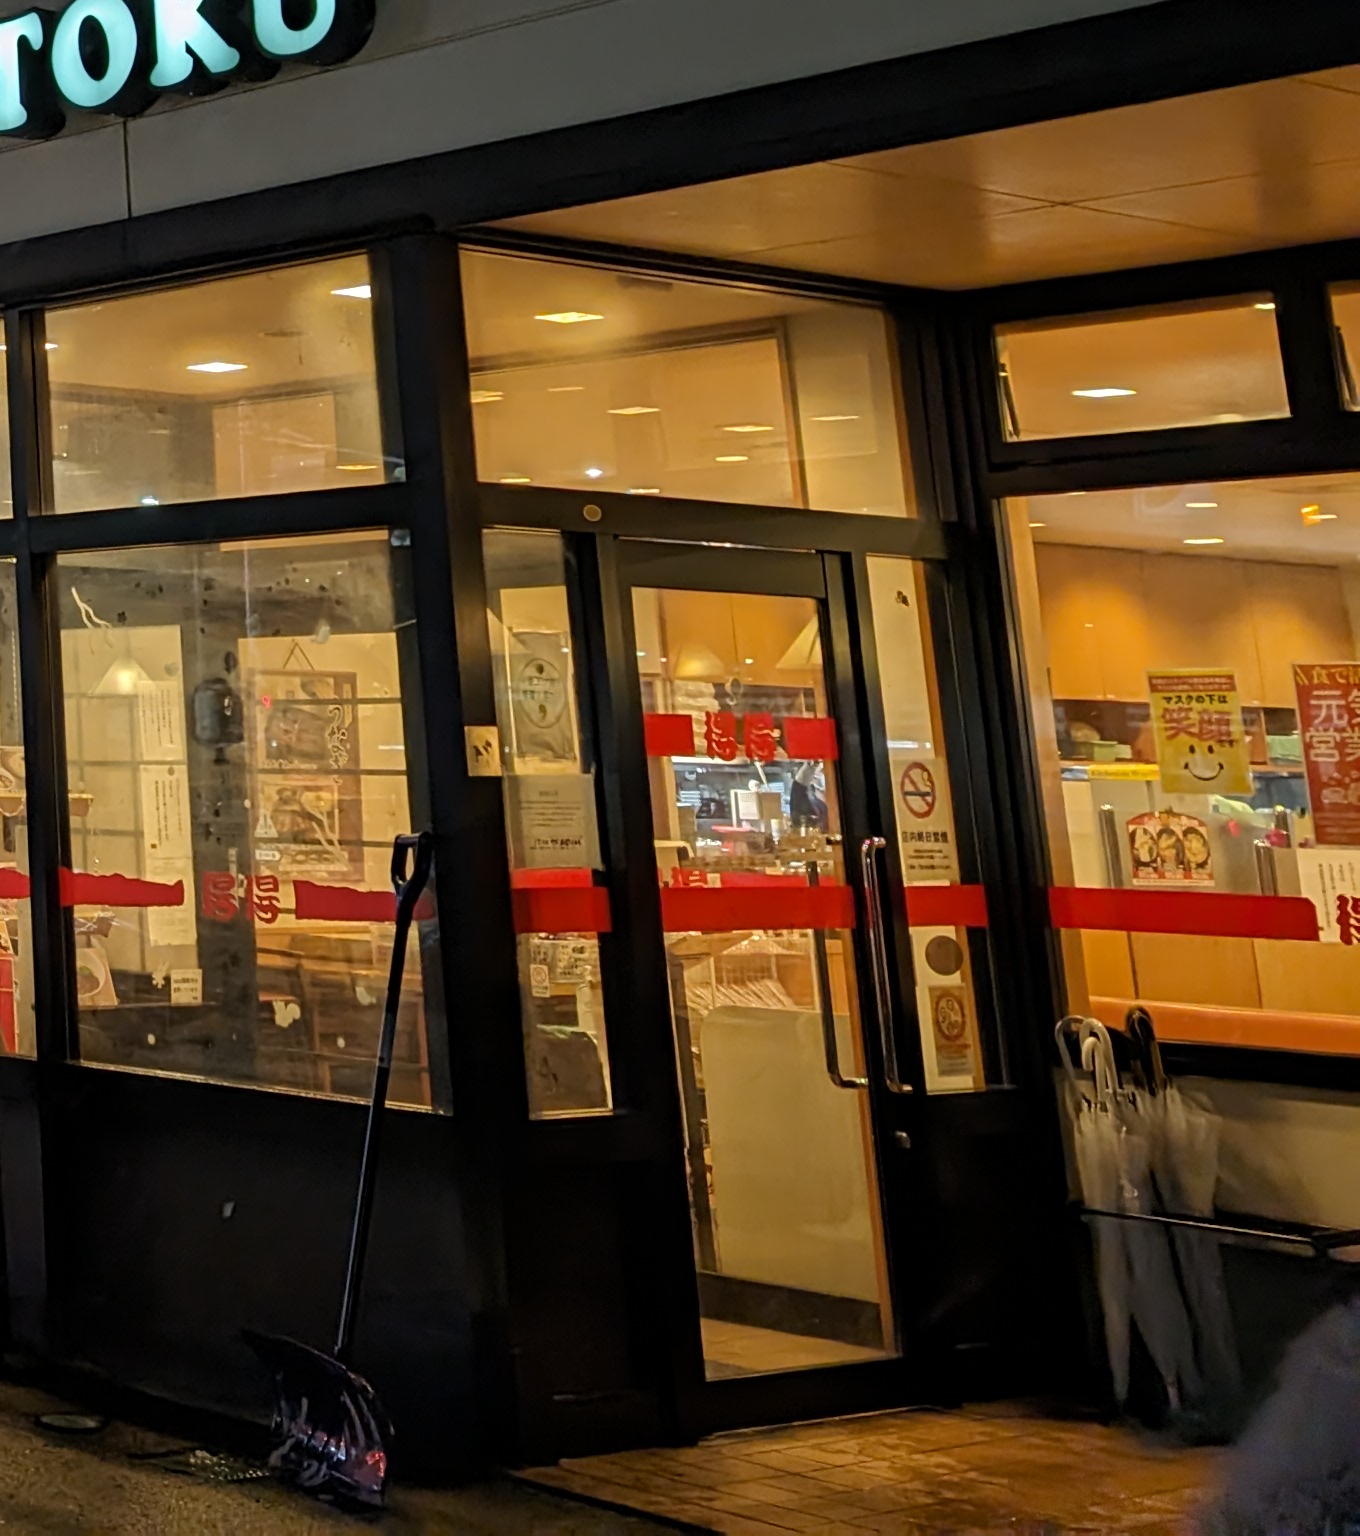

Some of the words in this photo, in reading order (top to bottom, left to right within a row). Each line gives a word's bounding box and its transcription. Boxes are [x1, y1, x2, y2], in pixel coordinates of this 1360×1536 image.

[1161, 693, 1229, 706] マスクの下は
[1161, 706, 1232, 742] 笑顔
